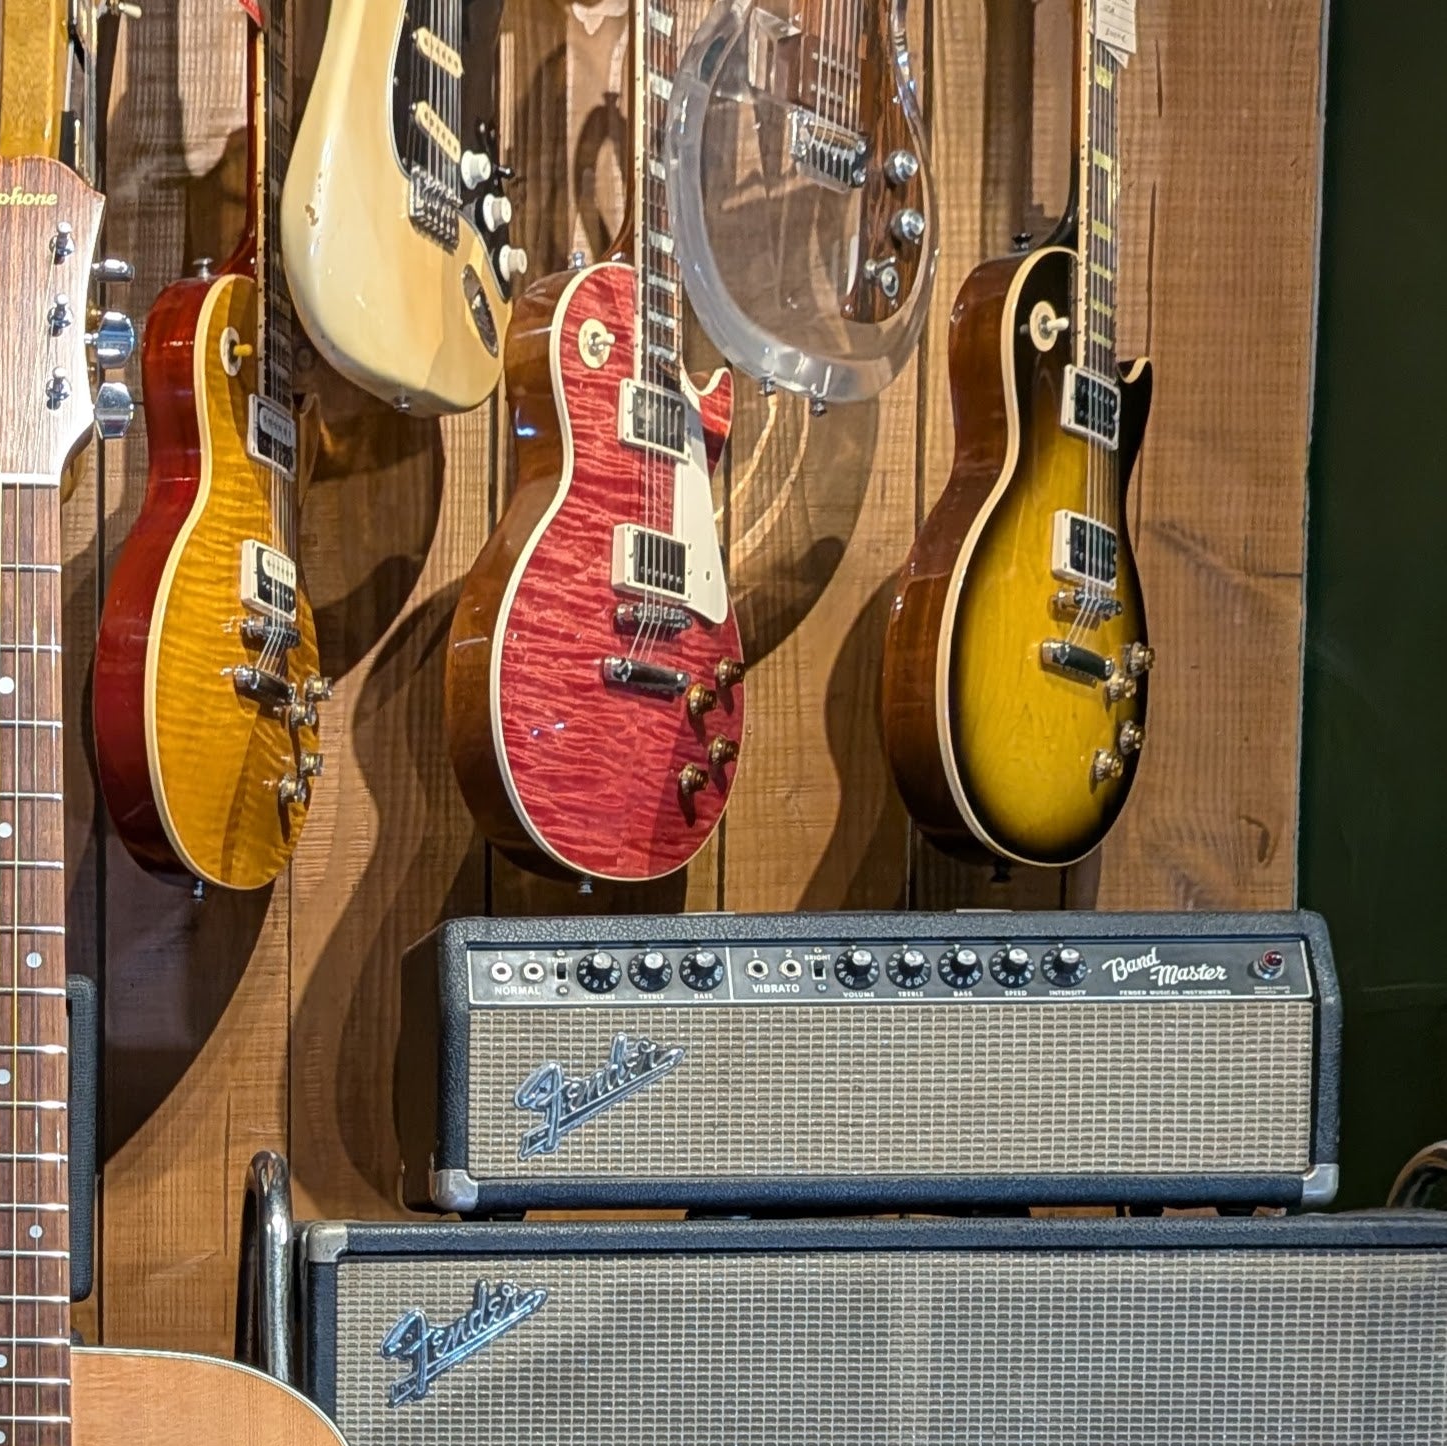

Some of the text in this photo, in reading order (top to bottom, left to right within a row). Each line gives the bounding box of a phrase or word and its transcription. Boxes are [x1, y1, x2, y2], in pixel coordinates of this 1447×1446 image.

[1102, 947, 1161, 983] Band
[494, 986, 541, 996] NORMAL
[752, 984, 800, 993] VIBRATO
[514, 1031, 686, 1160] Fender
[381, 1278, 548, 1408] Fender
